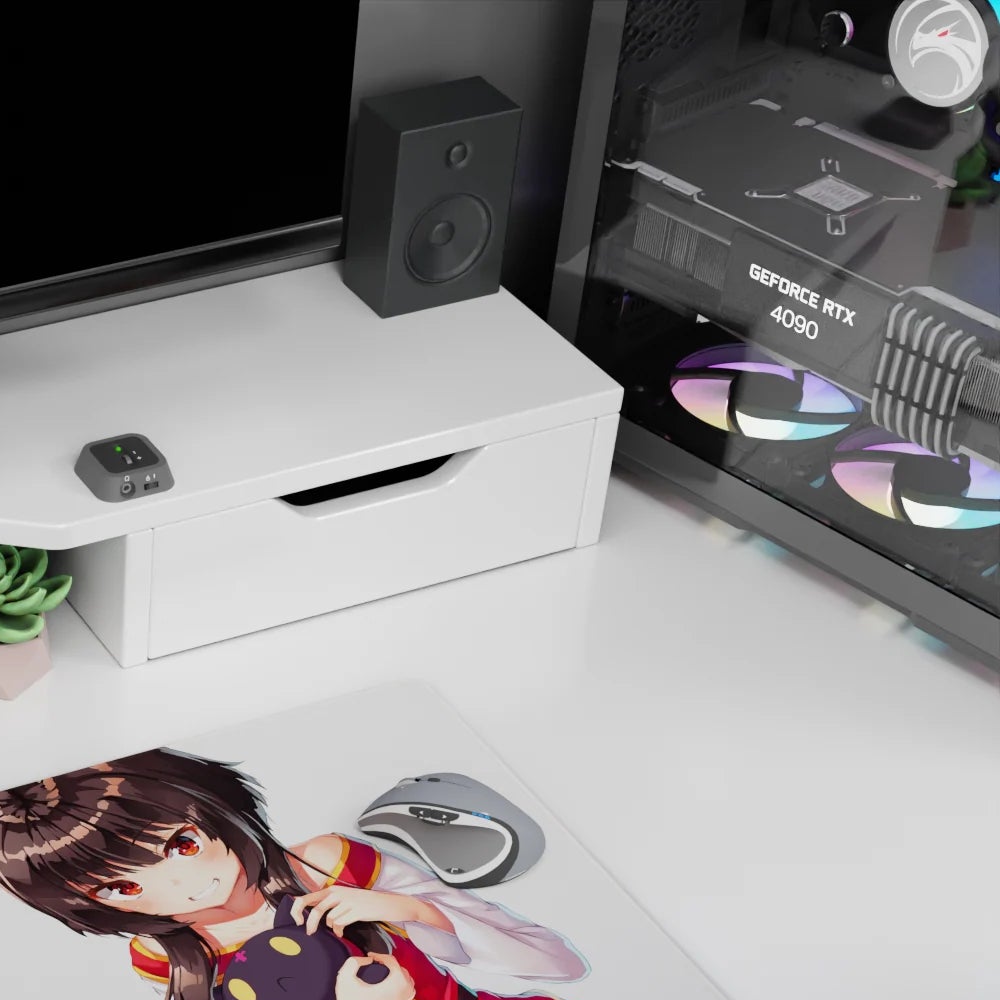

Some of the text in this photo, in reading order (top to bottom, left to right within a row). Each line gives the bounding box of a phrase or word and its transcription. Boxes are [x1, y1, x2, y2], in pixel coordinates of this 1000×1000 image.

[749, 263, 857, 327] GEFORCE RTX
[770, 305, 819, 340] 4090
